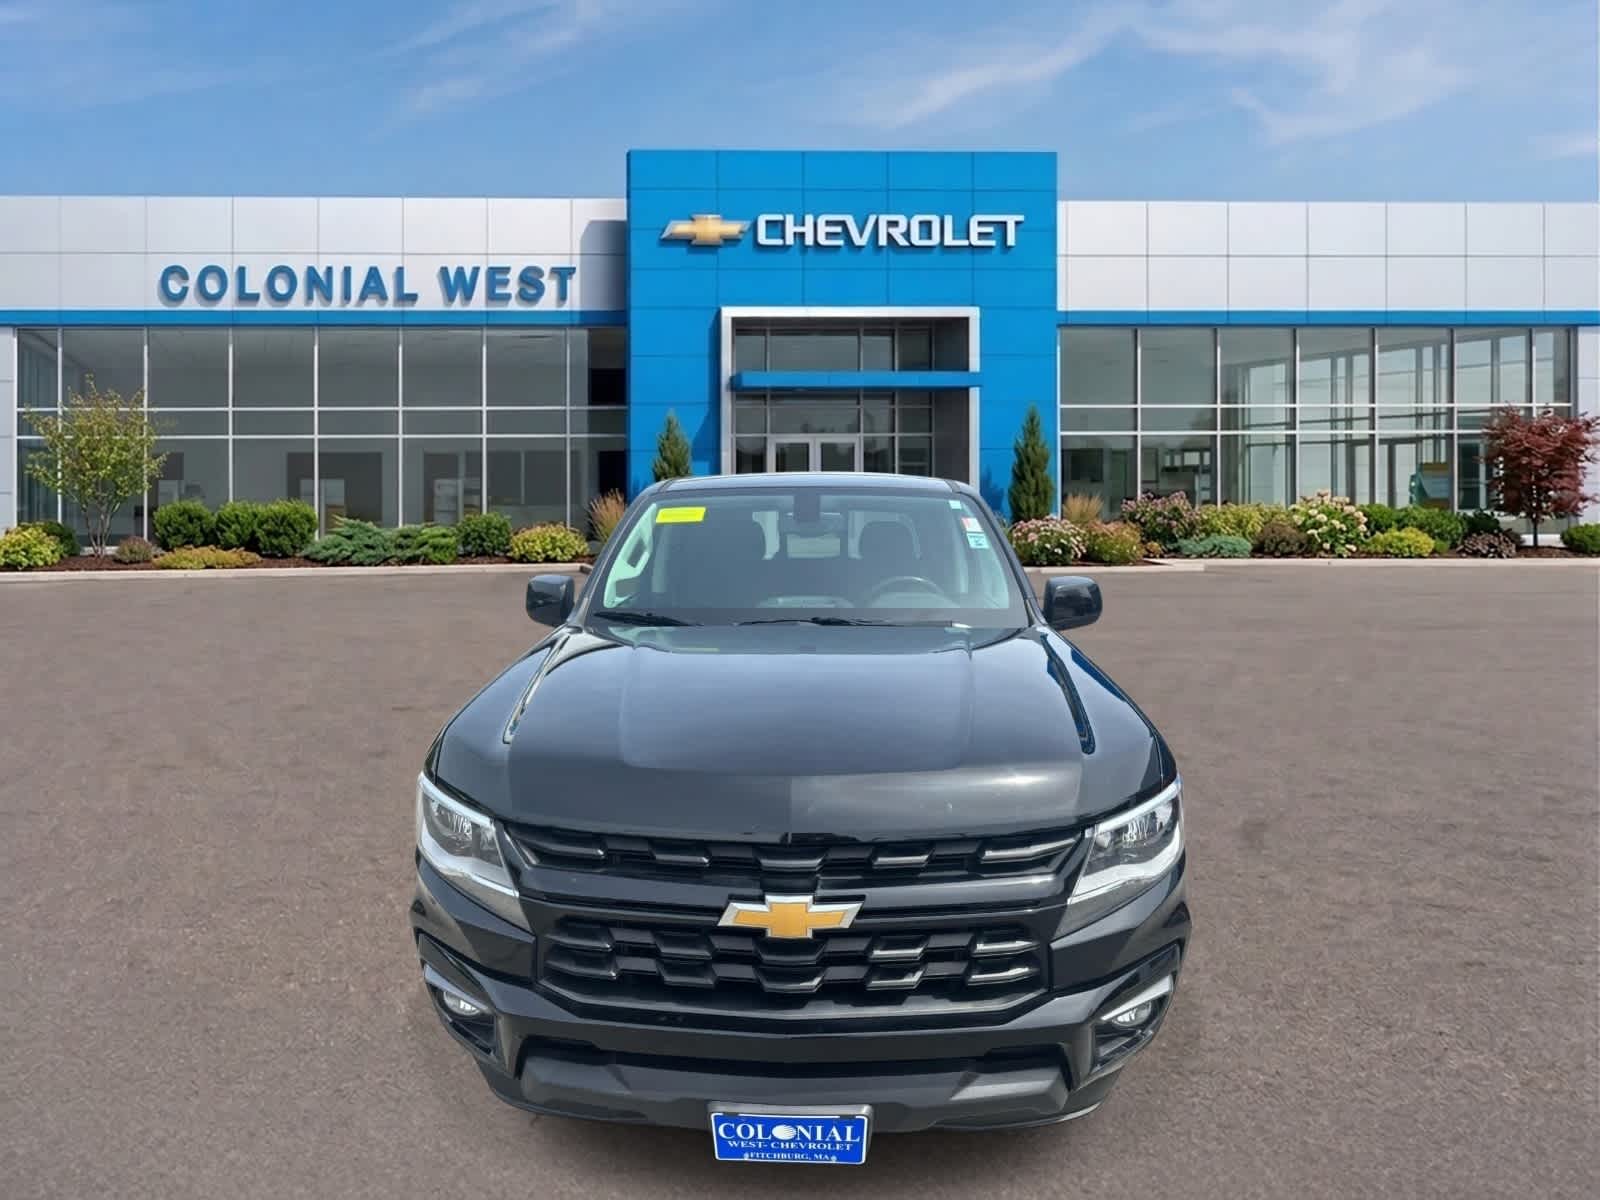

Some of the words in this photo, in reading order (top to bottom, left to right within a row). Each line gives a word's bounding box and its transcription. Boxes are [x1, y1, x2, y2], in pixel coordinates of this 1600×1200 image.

[756, 213, 1025, 248] CHEVROLET
[159, 264, 418, 306] COLONIAL
[438, 264, 577, 306] WEST
[718, 1122, 860, 1142] COLONIAL
[770, 1141, 853, 1151] CHEVROLET
